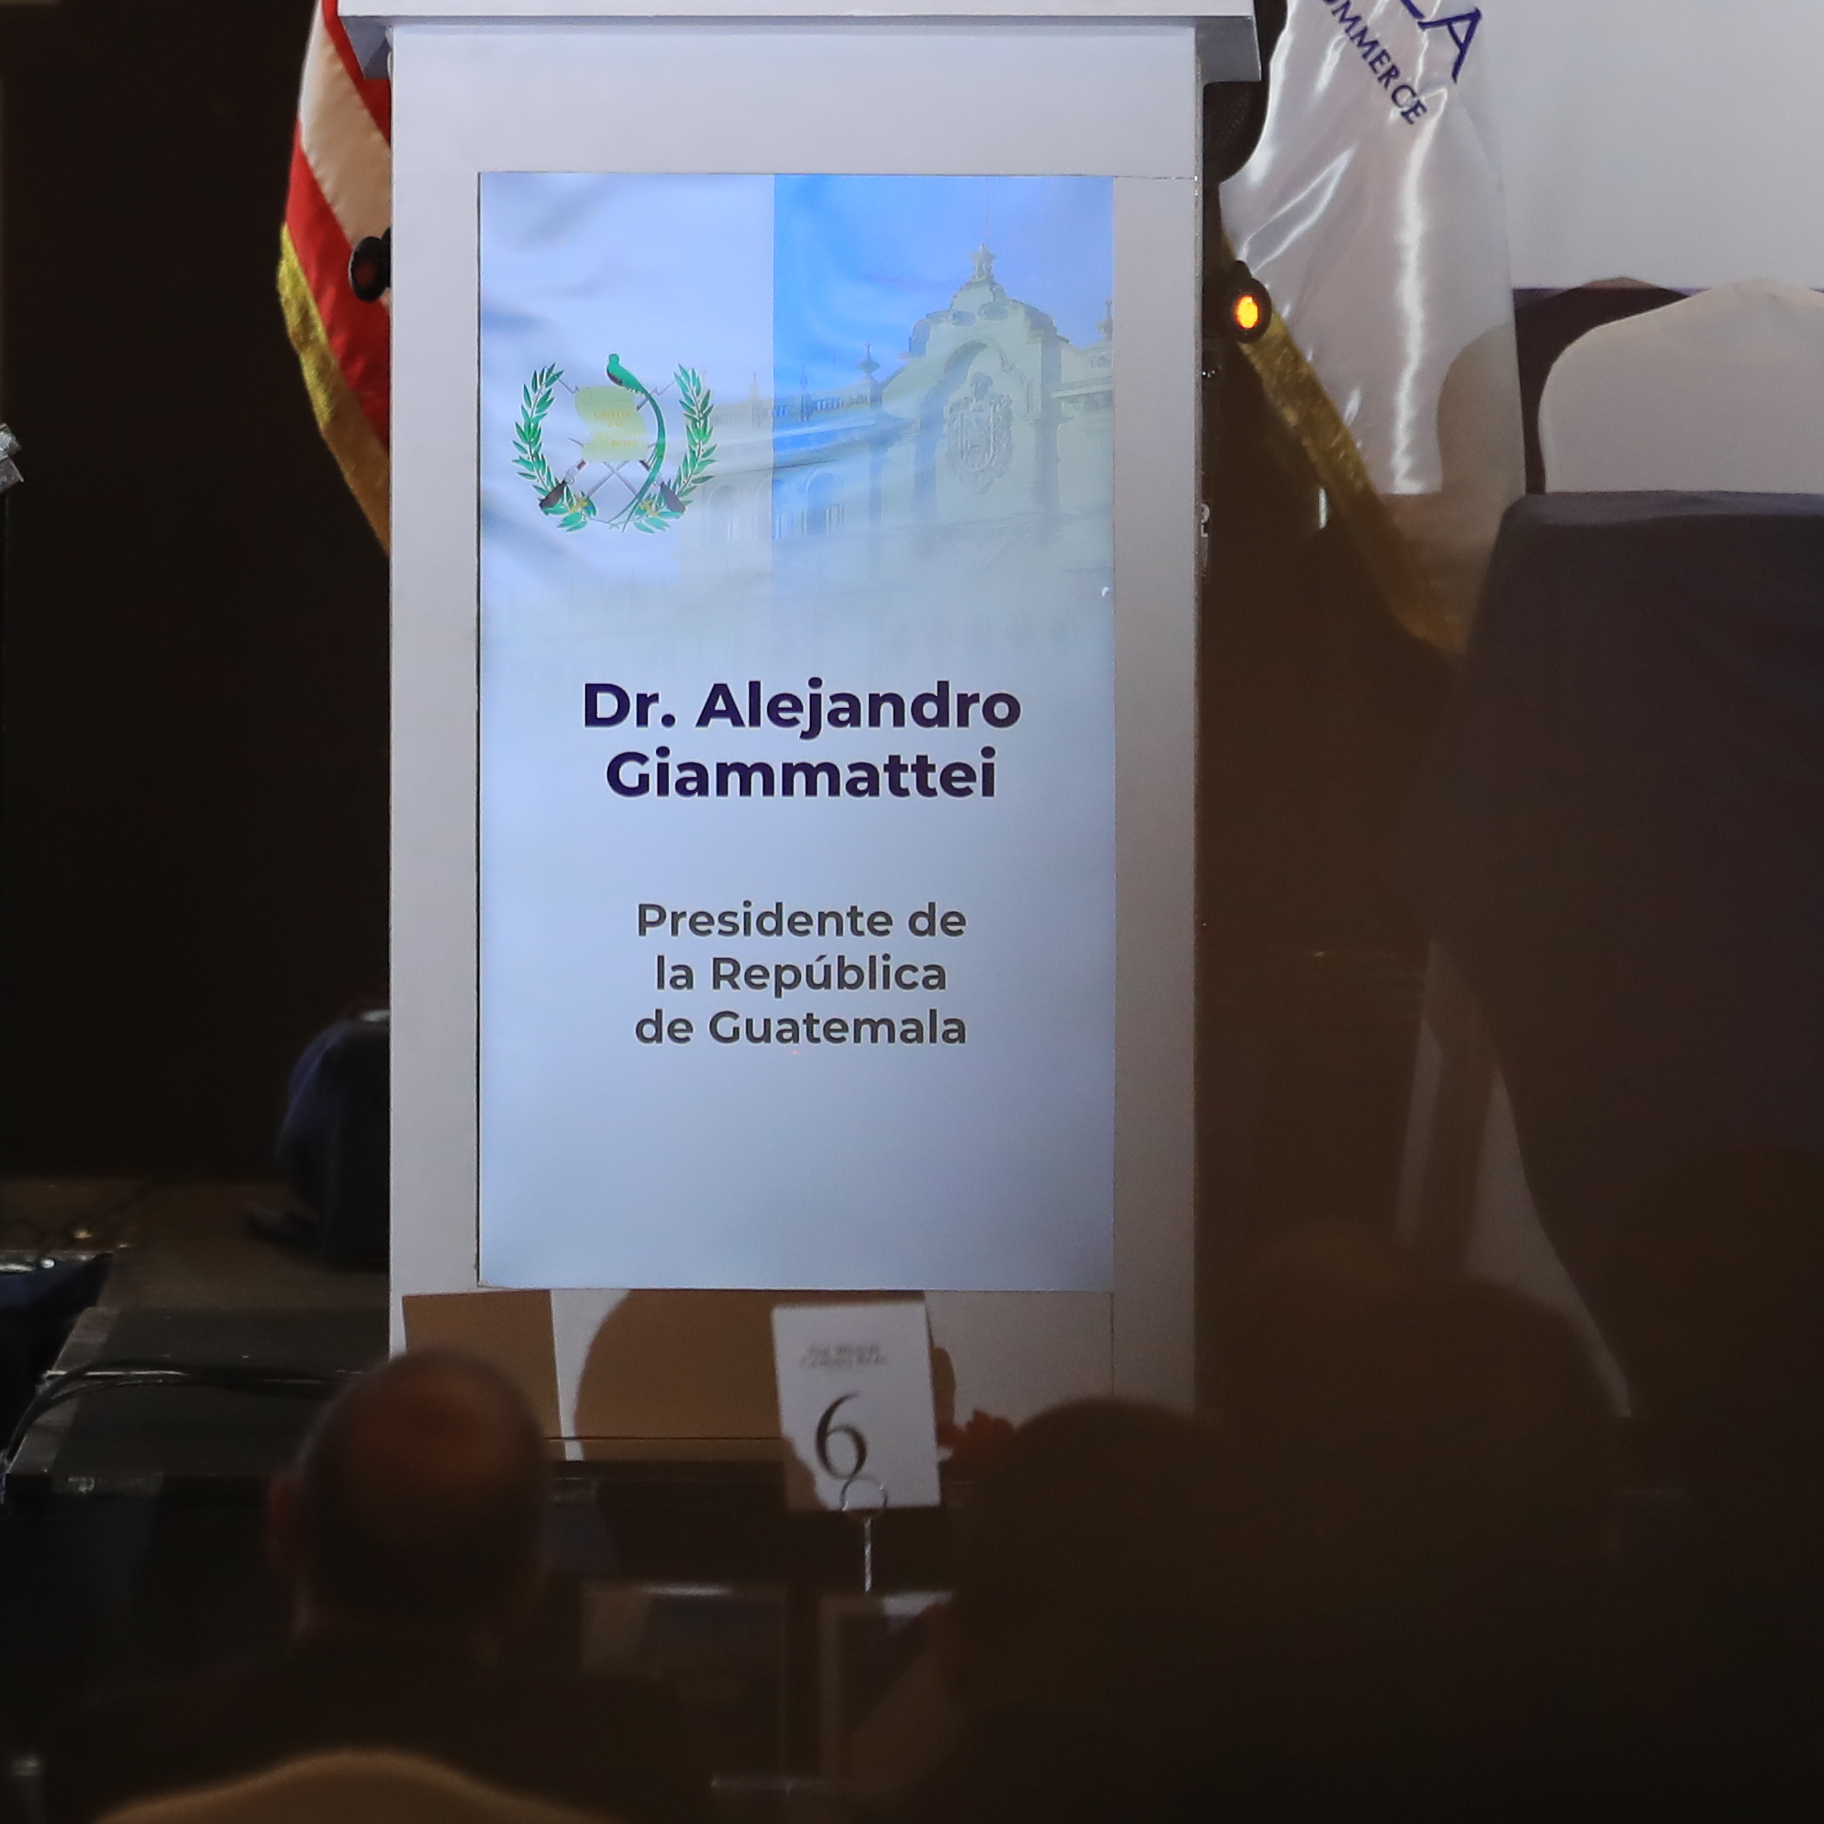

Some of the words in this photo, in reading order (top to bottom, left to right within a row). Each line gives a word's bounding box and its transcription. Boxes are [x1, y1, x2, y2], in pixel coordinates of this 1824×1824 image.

[584, 682, 676, 729] Dr.
[695, 676, 1023, 740] Alejandro
[606, 745, 998, 799] Giammattei
[637, 900, 895, 938] Presidente
[907, 901, 968, 938] de
[656, 954, 694, 991] la
[712, 953, 948, 999] República
[634, 1007, 695, 1045] de
[708, 1007, 968, 1045] Guatemala
[815, 1390, 868, 1480] 6
